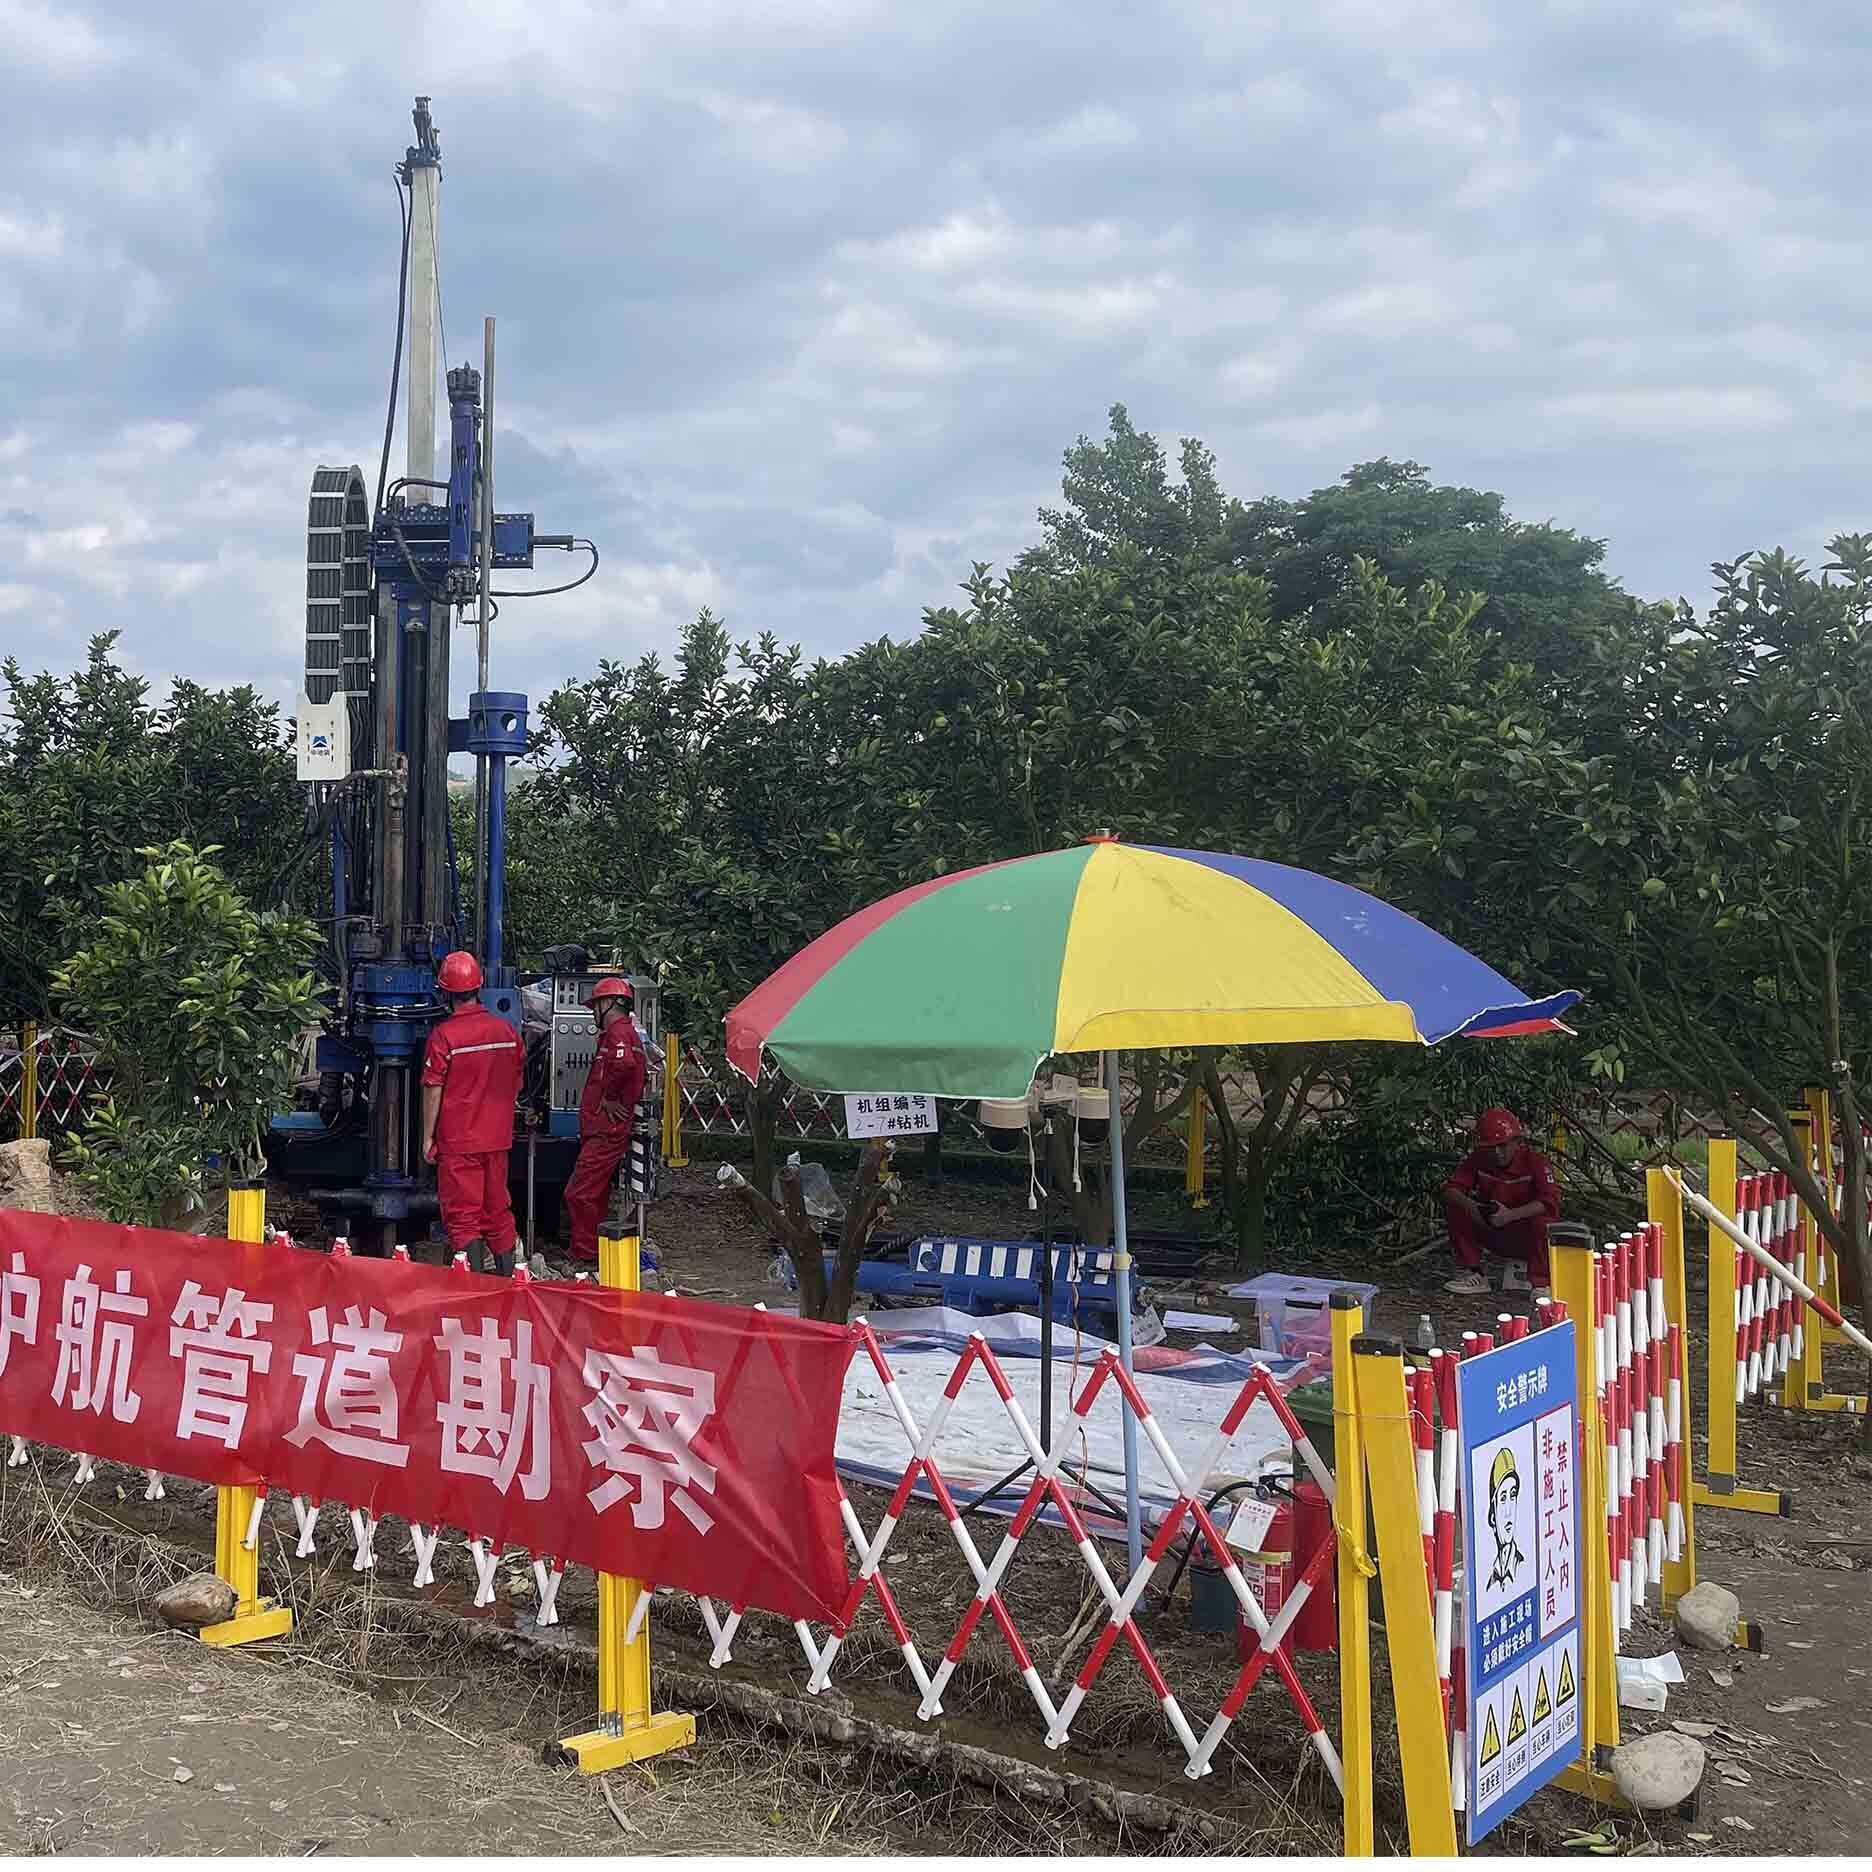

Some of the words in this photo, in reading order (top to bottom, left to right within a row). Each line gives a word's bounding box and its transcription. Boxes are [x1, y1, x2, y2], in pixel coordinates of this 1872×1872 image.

[857, 1095, 927, 1113] 机组编号
[1496, 1363, 1548, 1414] 安全警示牌
[1542, 1427, 1557, 1621] 非施工人员
[1556, 1439, 1570, 1594] 禁止入内
